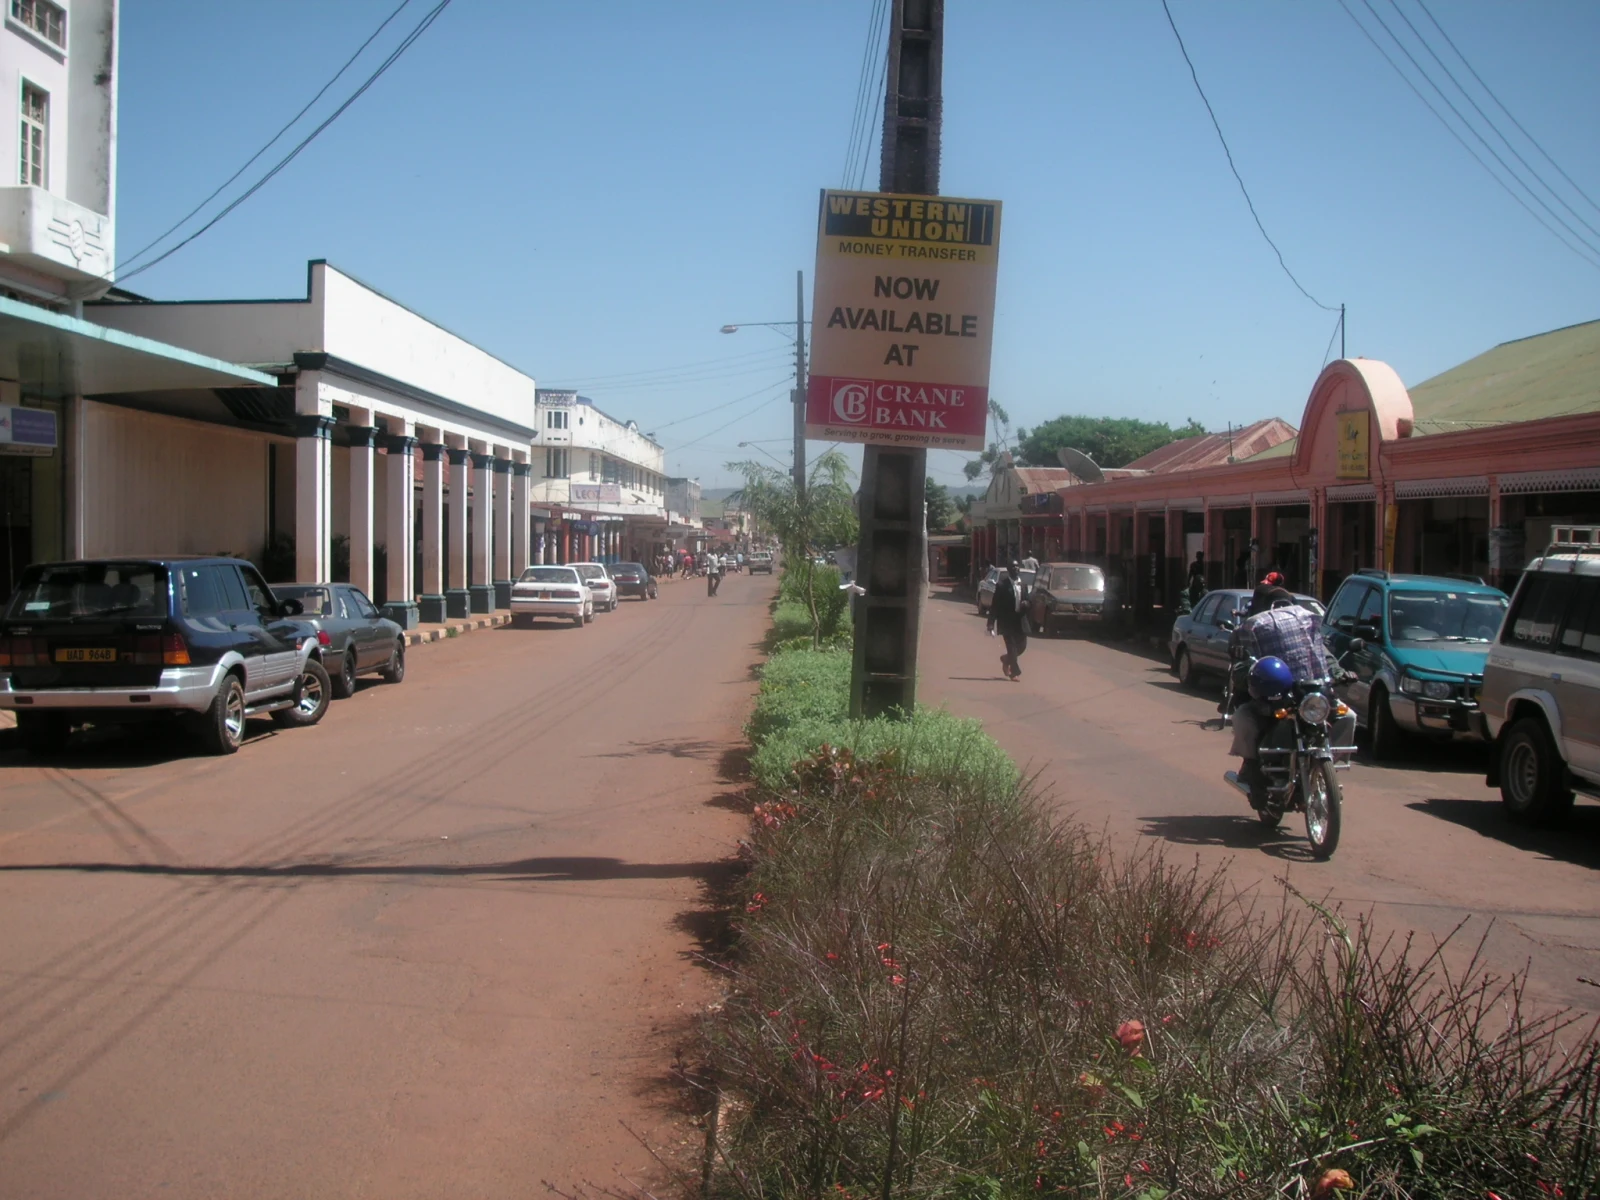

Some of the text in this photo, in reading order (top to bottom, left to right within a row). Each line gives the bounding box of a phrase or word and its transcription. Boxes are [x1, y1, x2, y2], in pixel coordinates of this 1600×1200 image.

[828, 195, 966, 223] WESTERN
[870, 218, 965, 242] UNION
[838, 241, 977, 262] MONEY TRANSFER
[873, 275, 940, 302] NOW
[826, 306, 978, 338] AVAILABLE
[882, 343, 919, 367] AT
[875, 384, 966, 407] CRANE
[875, 407, 948, 429] BANK
[824, 427, 967, 445] Serving to grow, growing to serve
